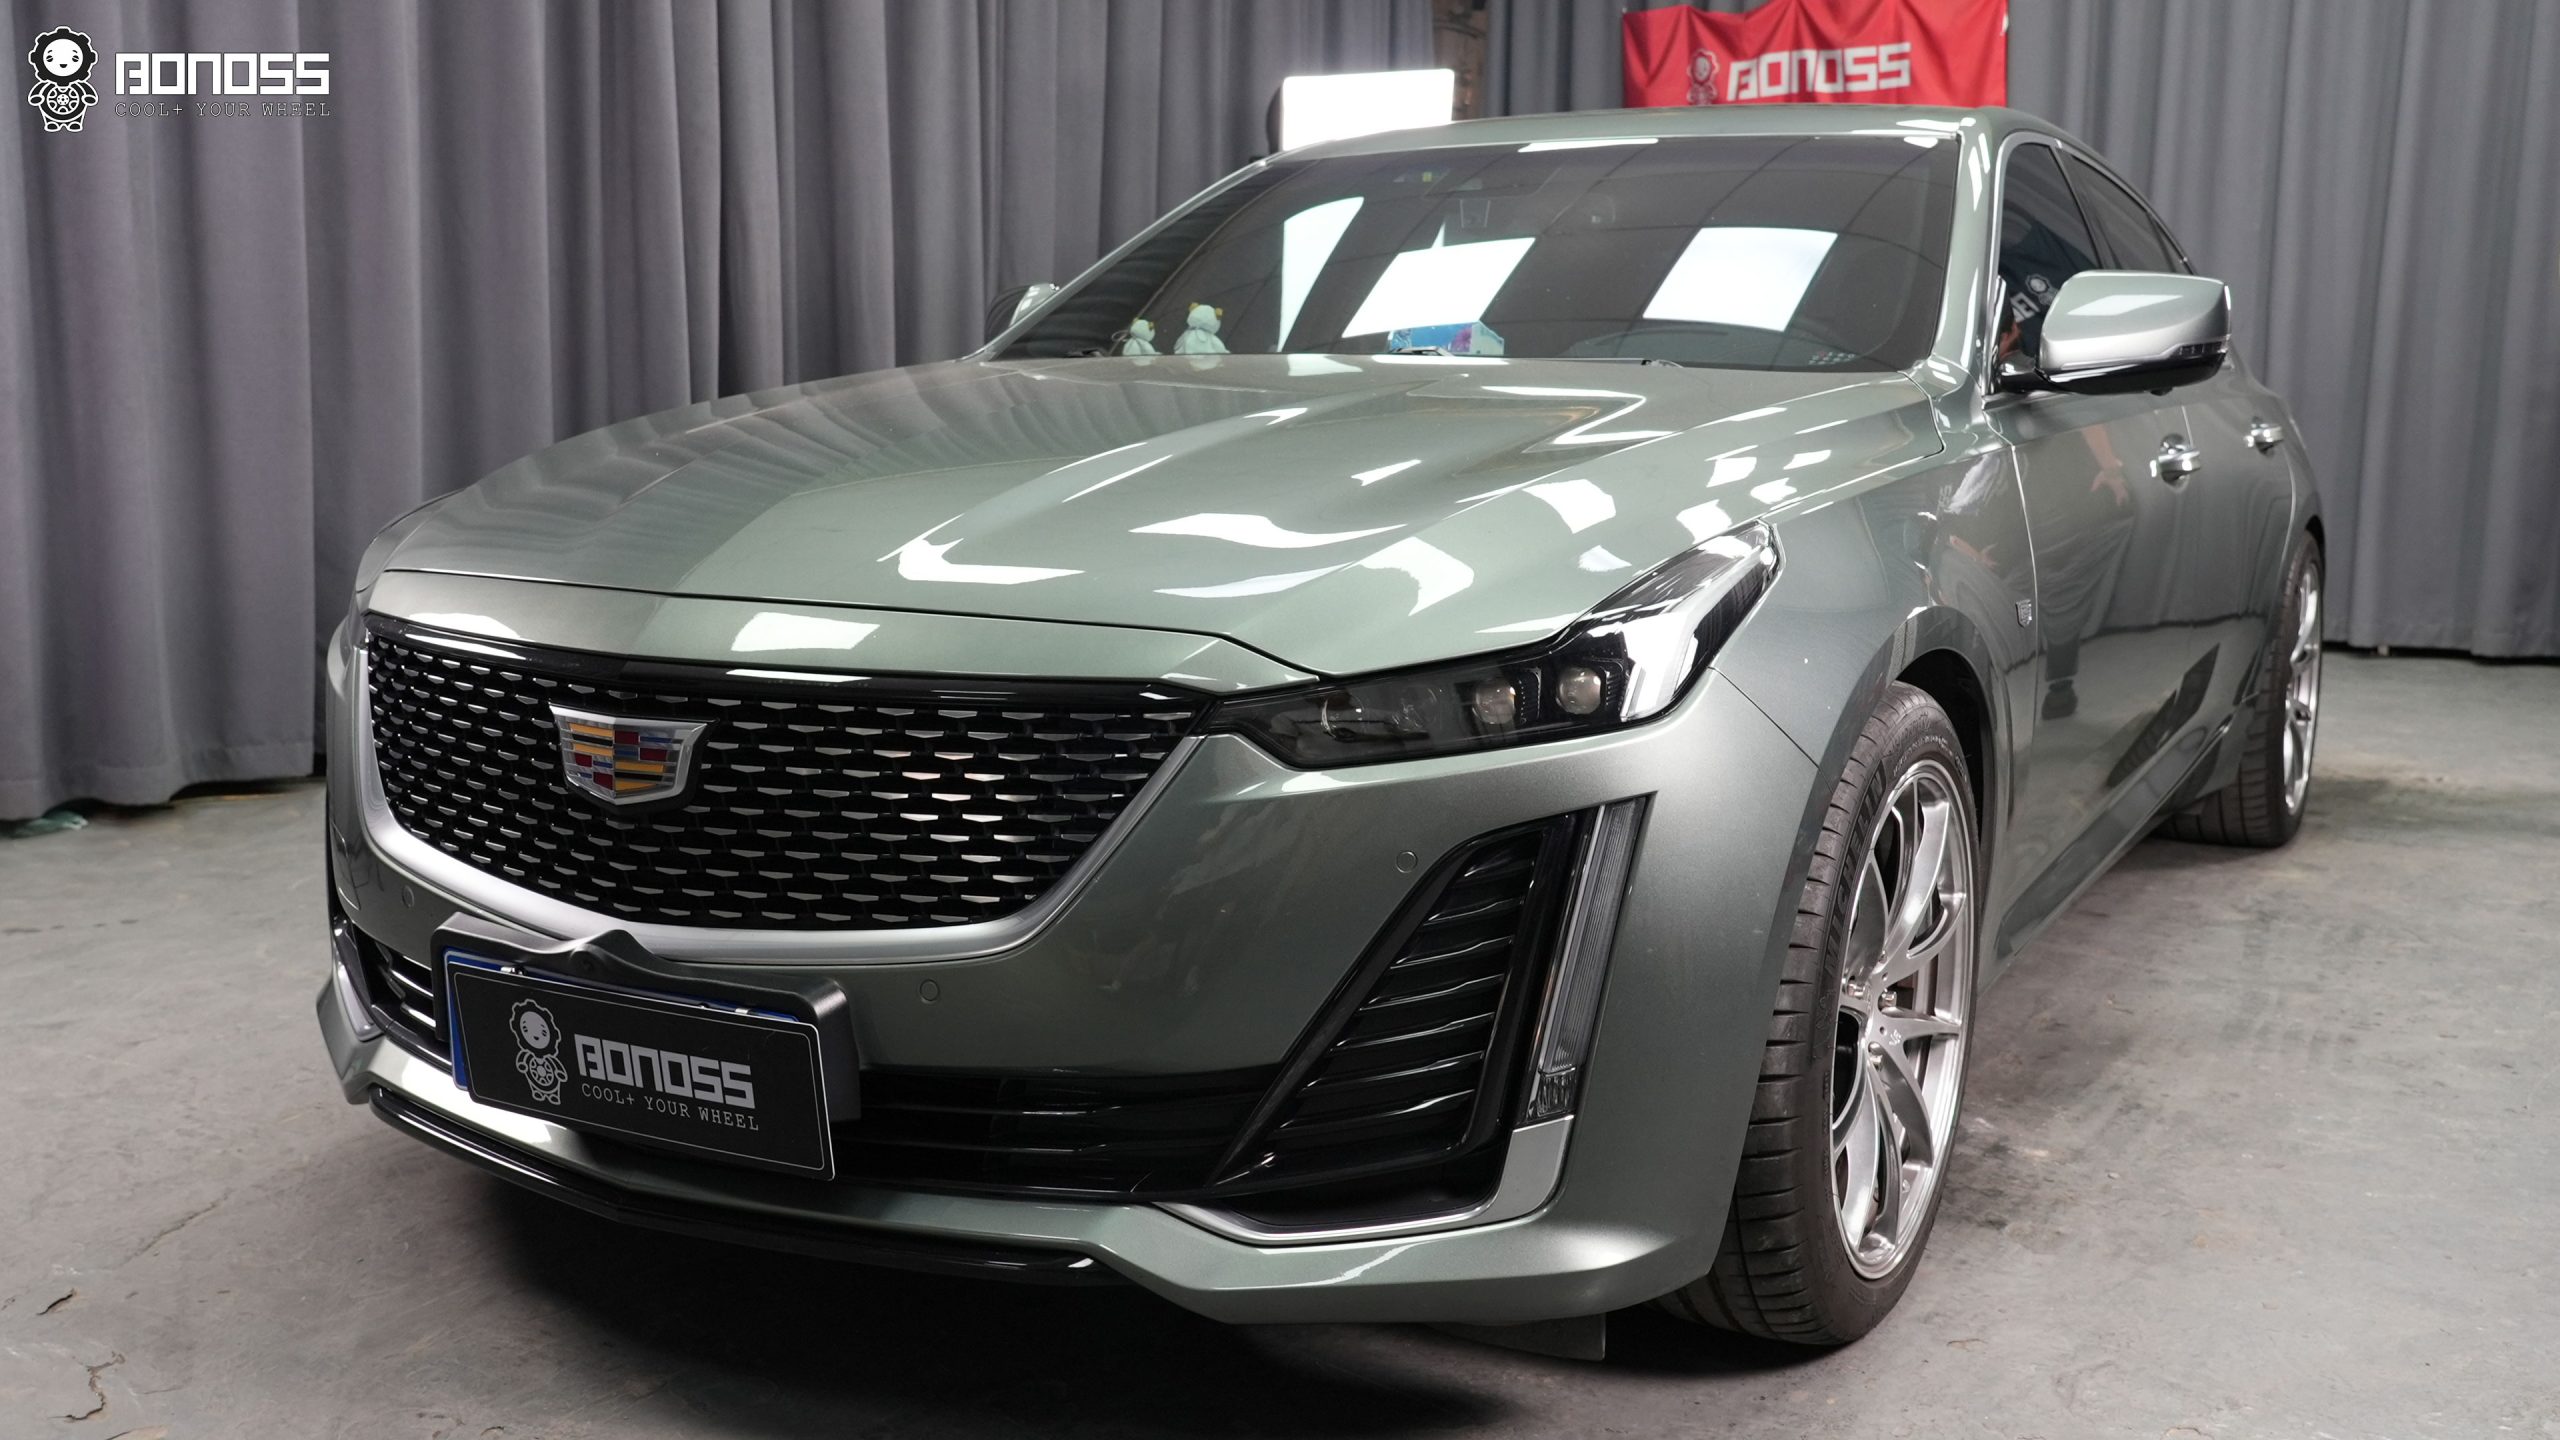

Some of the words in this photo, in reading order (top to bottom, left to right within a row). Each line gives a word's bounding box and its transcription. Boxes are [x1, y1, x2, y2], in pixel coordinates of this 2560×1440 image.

[1727, 42, 1912, 101] BONOSS
[574, 1033, 755, 1109] BONOSS
[581, 1083, 635, 1106] COOL+
[645, 1096, 690, 1118] YOUR
[698, 1106, 760, 1131] WHEEL
